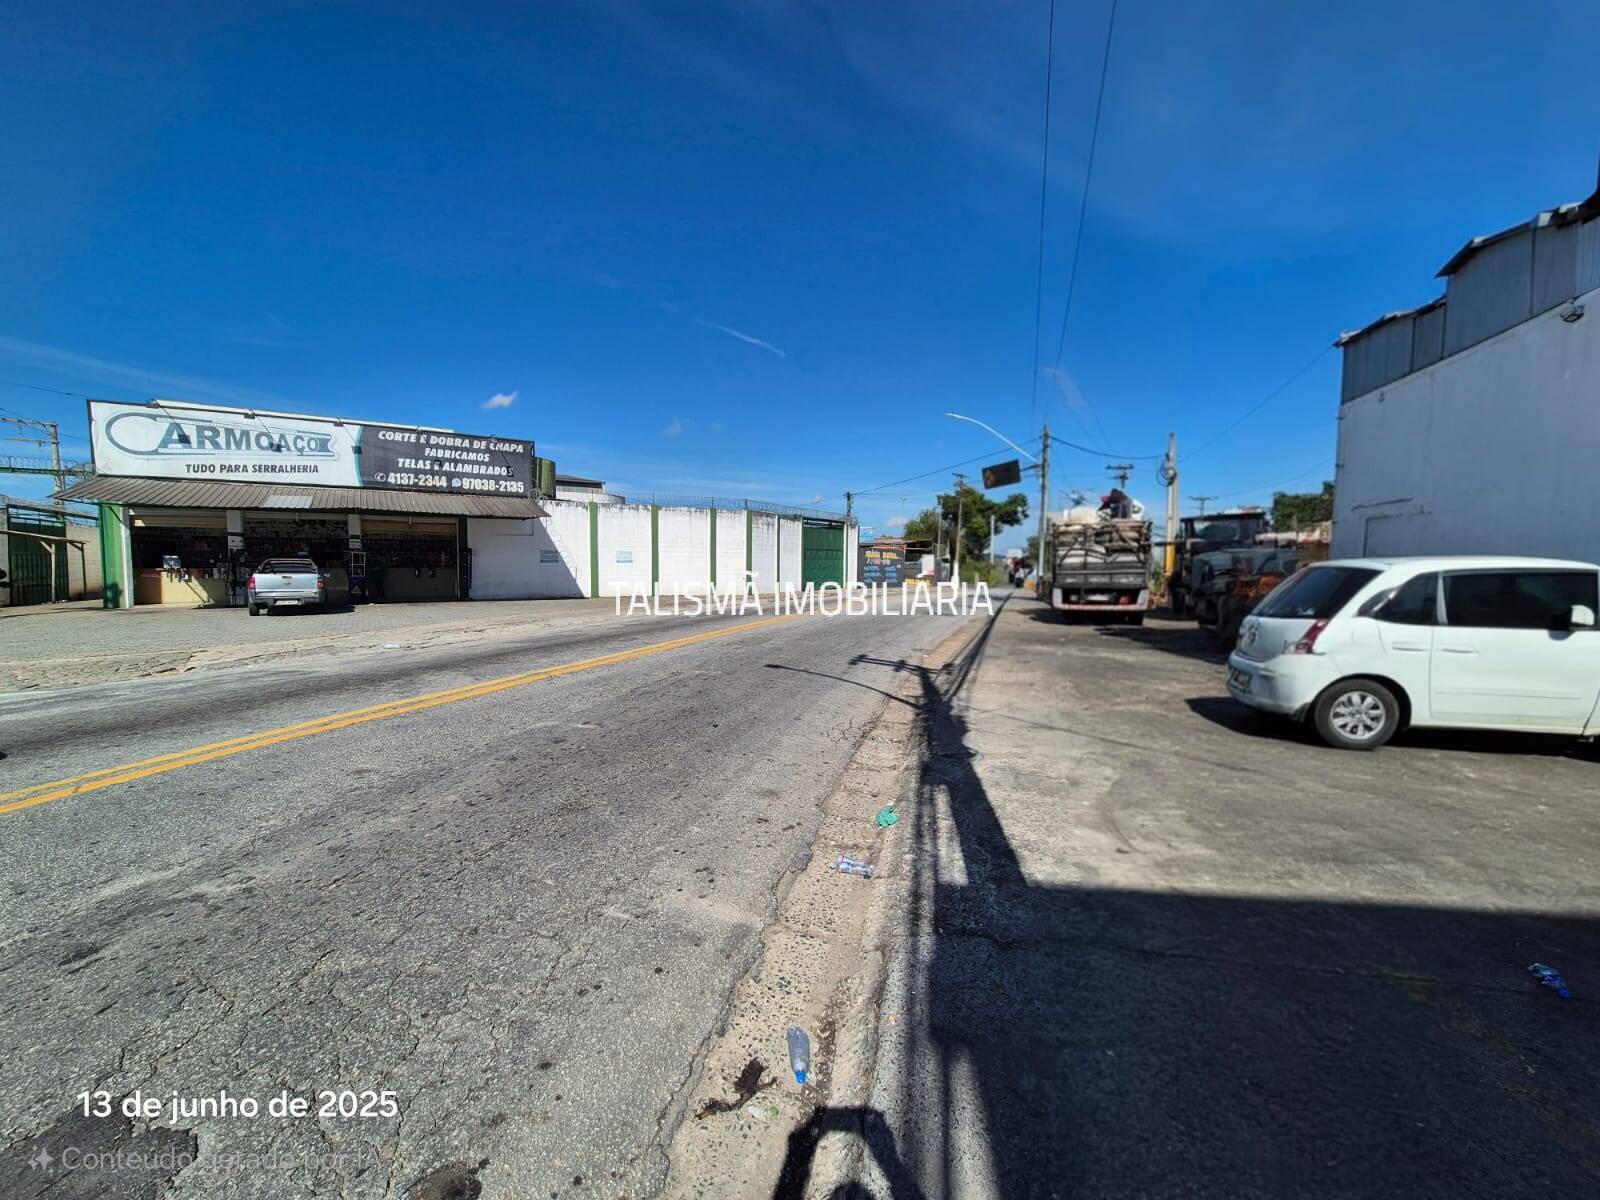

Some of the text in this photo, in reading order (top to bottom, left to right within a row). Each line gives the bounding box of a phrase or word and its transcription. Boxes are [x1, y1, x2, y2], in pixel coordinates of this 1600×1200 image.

[378, 430, 524, 453] CORTE E DOBRA DE CHAPA
[424, 447, 490, 462] FABRICAMOS
[185, 464, 319, 474] TUDO PARA SERRALHERIA
[398, 458, 431, 470] TELAS
[442, 462, 514, 477] ALAMBRADOS
[387, 472, 525, 493] 4137-2344 97038-2135
